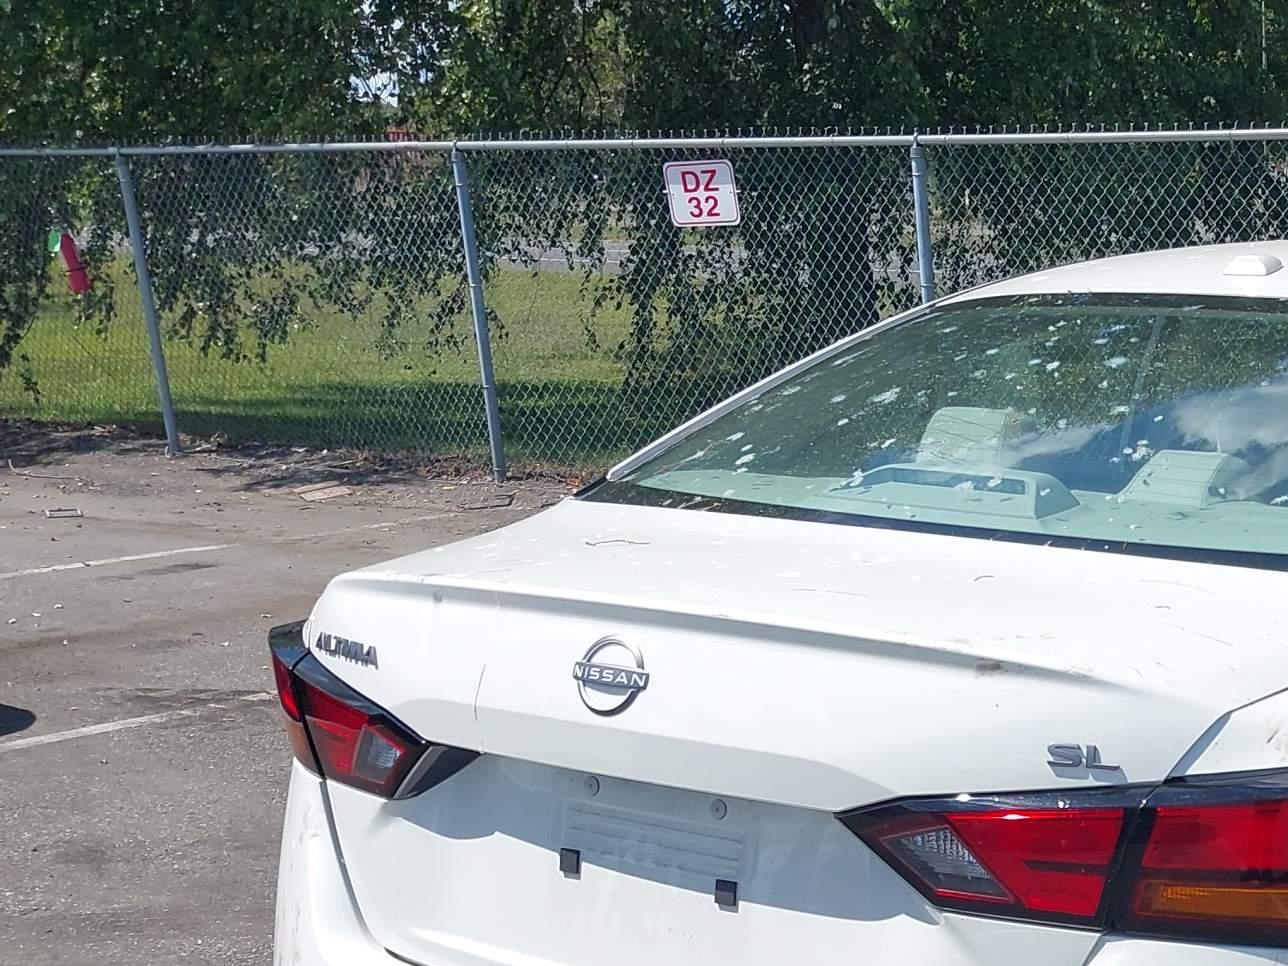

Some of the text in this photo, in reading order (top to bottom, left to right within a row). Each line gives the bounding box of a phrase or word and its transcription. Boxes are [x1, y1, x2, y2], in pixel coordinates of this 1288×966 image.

[680, 169, 720, 193] DZ
[687, 195, 721, 218] 32
[573, 663, 647, 688] NISSAN
[1046, 744, 1121, 772] SL
